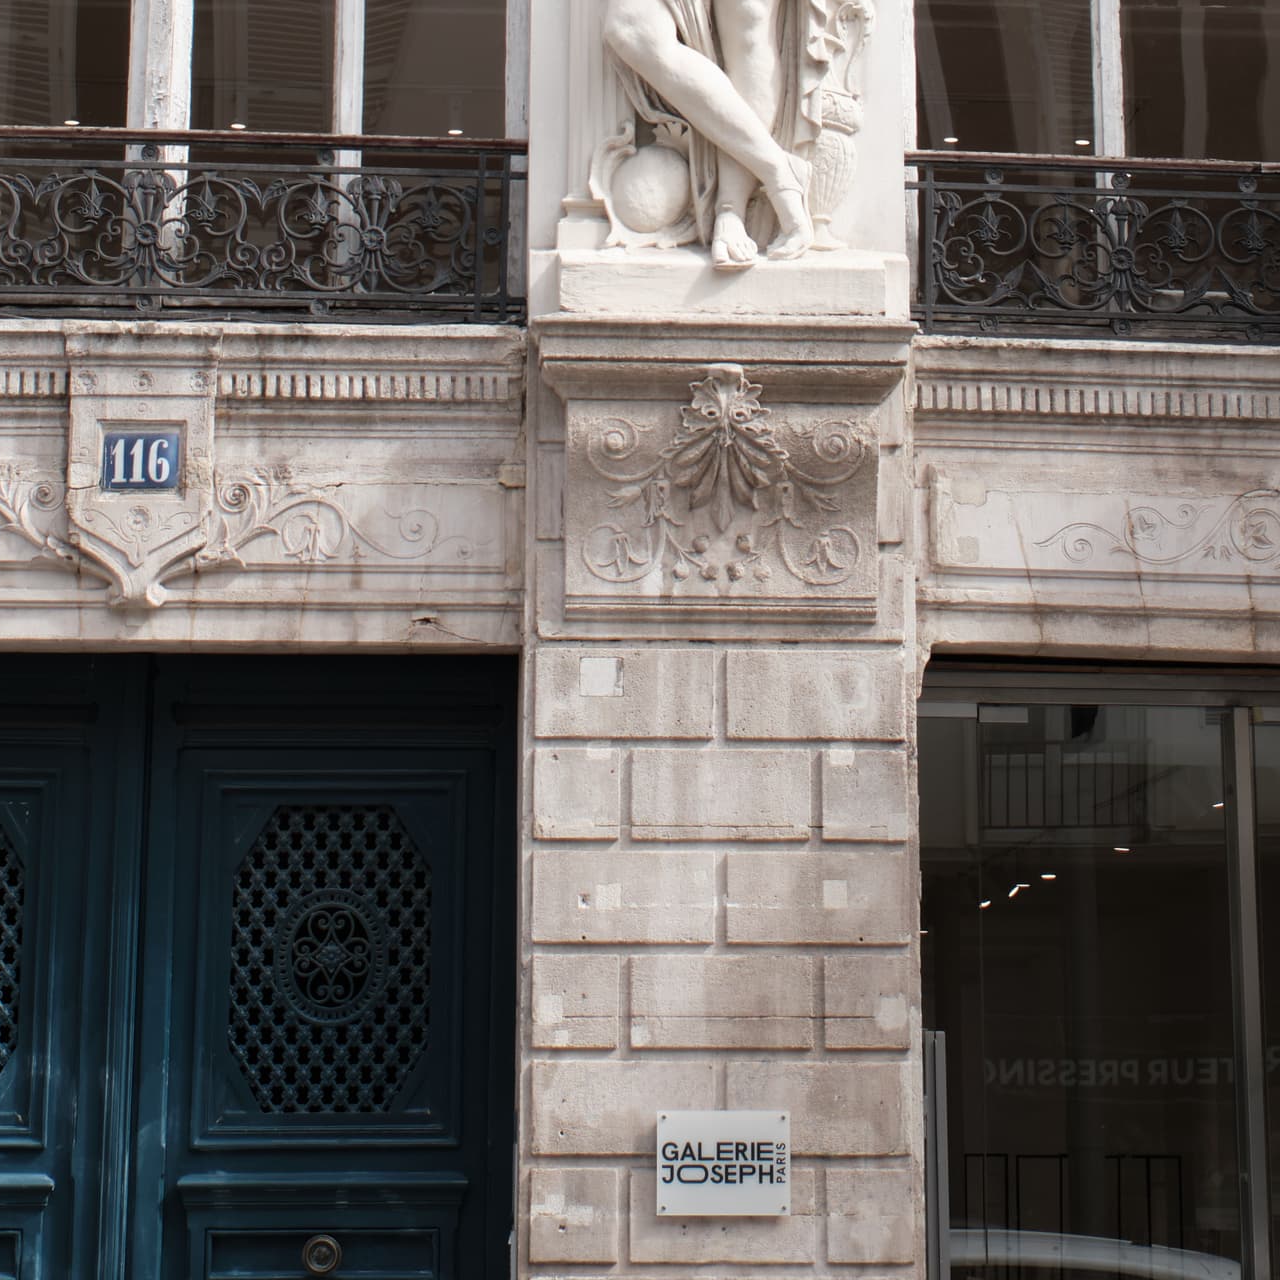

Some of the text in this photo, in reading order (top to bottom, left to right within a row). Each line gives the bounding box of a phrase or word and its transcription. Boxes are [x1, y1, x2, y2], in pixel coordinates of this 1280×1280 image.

[111, 438, 170, 483] 116
[661, 1141, 774, 1162] GALERIE
[776, 1142, 786, 1184] PARIS
[661, 1164, 774, 1185] JOSEPH
